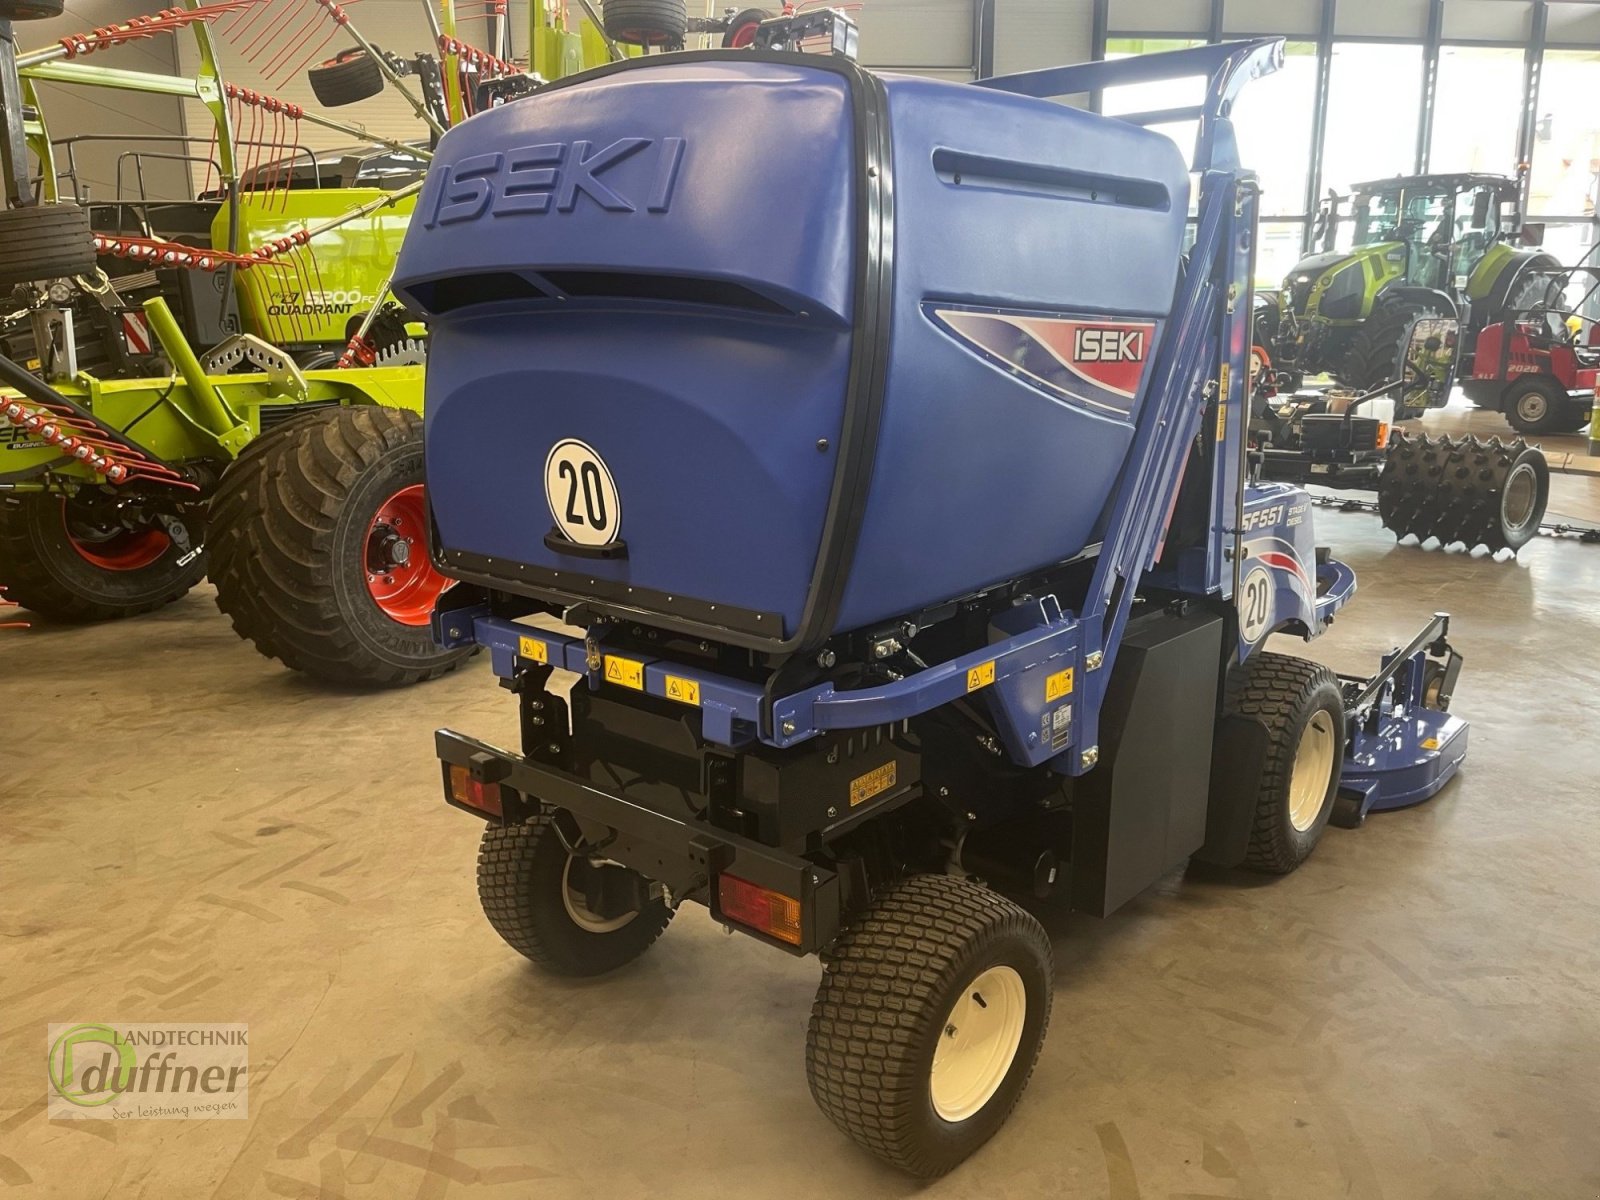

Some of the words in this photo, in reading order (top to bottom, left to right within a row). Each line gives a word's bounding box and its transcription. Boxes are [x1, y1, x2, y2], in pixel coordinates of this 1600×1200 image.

[424, 137, 686, 230] ISEKI
[268, 304, 353, 315] QUADRANT
[1073, 328, 1143, 362] ISEKI
[559, 460, 607, 531] 20
[1246, 577, 1268, 629] 20
